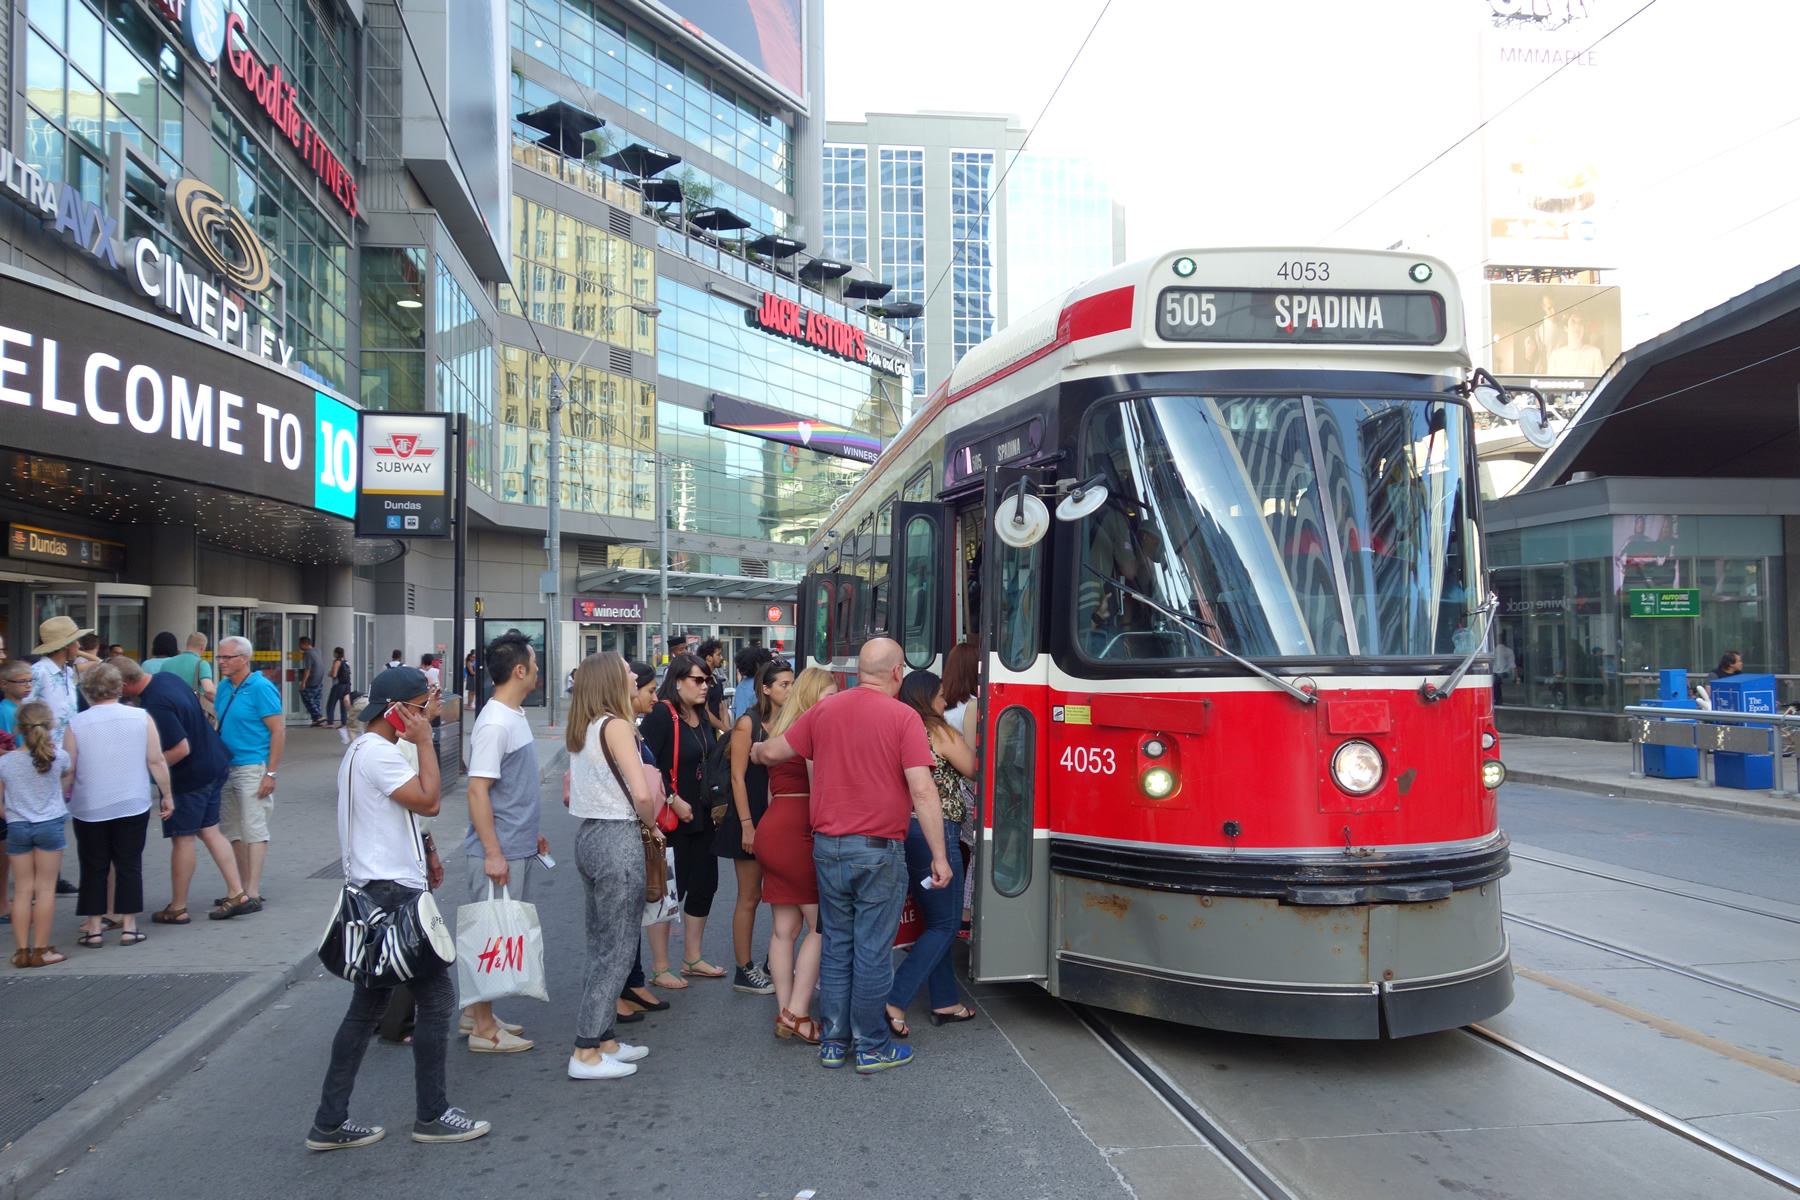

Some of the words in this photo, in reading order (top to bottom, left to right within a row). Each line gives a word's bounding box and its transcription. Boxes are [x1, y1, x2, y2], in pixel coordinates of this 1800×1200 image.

[226, 12, 299, 147] GoodLife
[303, 122, 358, 217] FITNESS
[55, 182, 119, 270] AVX
[1276, 261, 1330, 281] 4053
[1166, 293, 1217, 327] 505
[1275, 294, 1384, 329] SPADINA
[758, 291, 802, 339] JACK
[805, 310, 867, 362] ASTOR'S
[0, 326, 244, 456] ELCOME
[256, 402, 302, 471] TO
[320, 420, 357, 493] 10
[843, 445, 879, 462] WINNERS
[972, 453, 983, 472] 505
[997, 438, 1021, 461] SPADINA
[376, 461, 431, 473] SUBWAY
[384, 500, 422, 510] Dundas
[29, 532, 67, 556] Dundas
[593, 604, 619, 618] wine
[1748, 697, 1762, 705] The
[1748, 704, 1770, 713] Epoch
[1060, 746, 1116, 775] 4053
[477, 934, 524, 974] H&M
